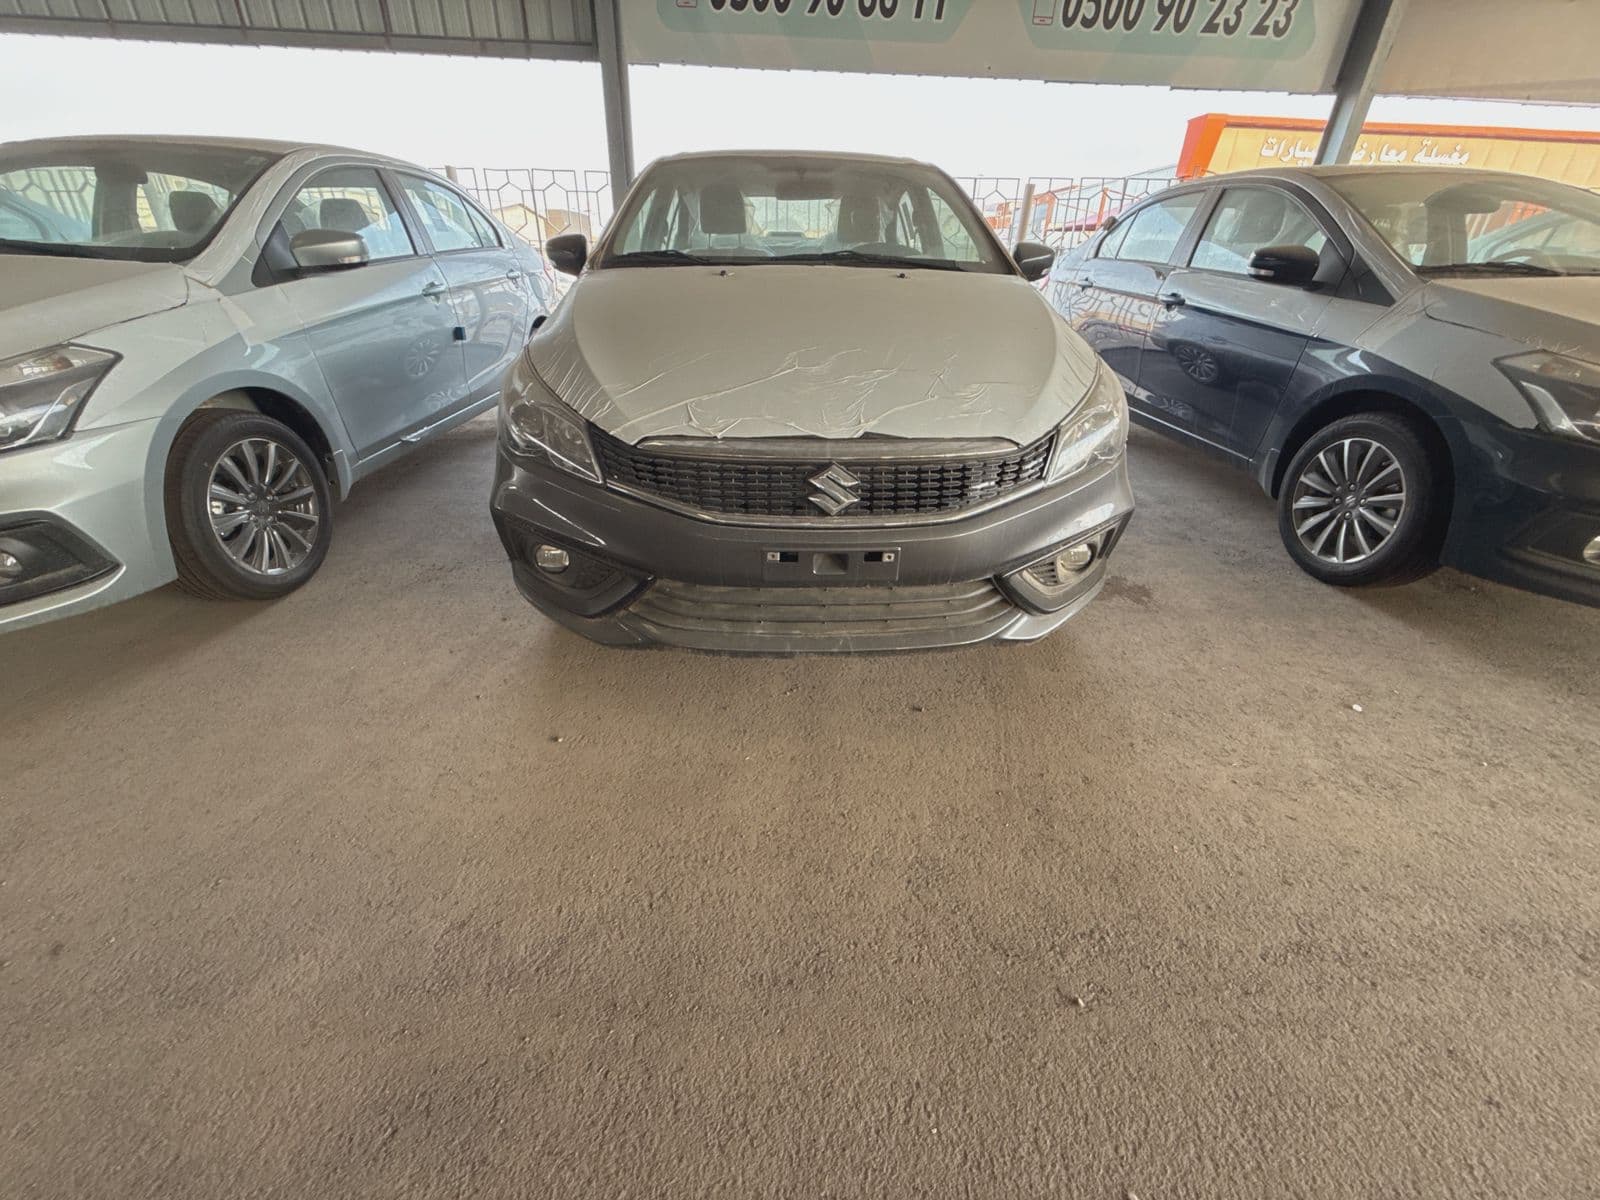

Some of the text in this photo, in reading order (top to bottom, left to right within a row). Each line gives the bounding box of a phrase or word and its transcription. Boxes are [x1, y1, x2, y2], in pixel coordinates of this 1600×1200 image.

[1061, 0, 1299, 38] 0500 90 23 23
[1412, 138, 1470, 165] مغسلة
